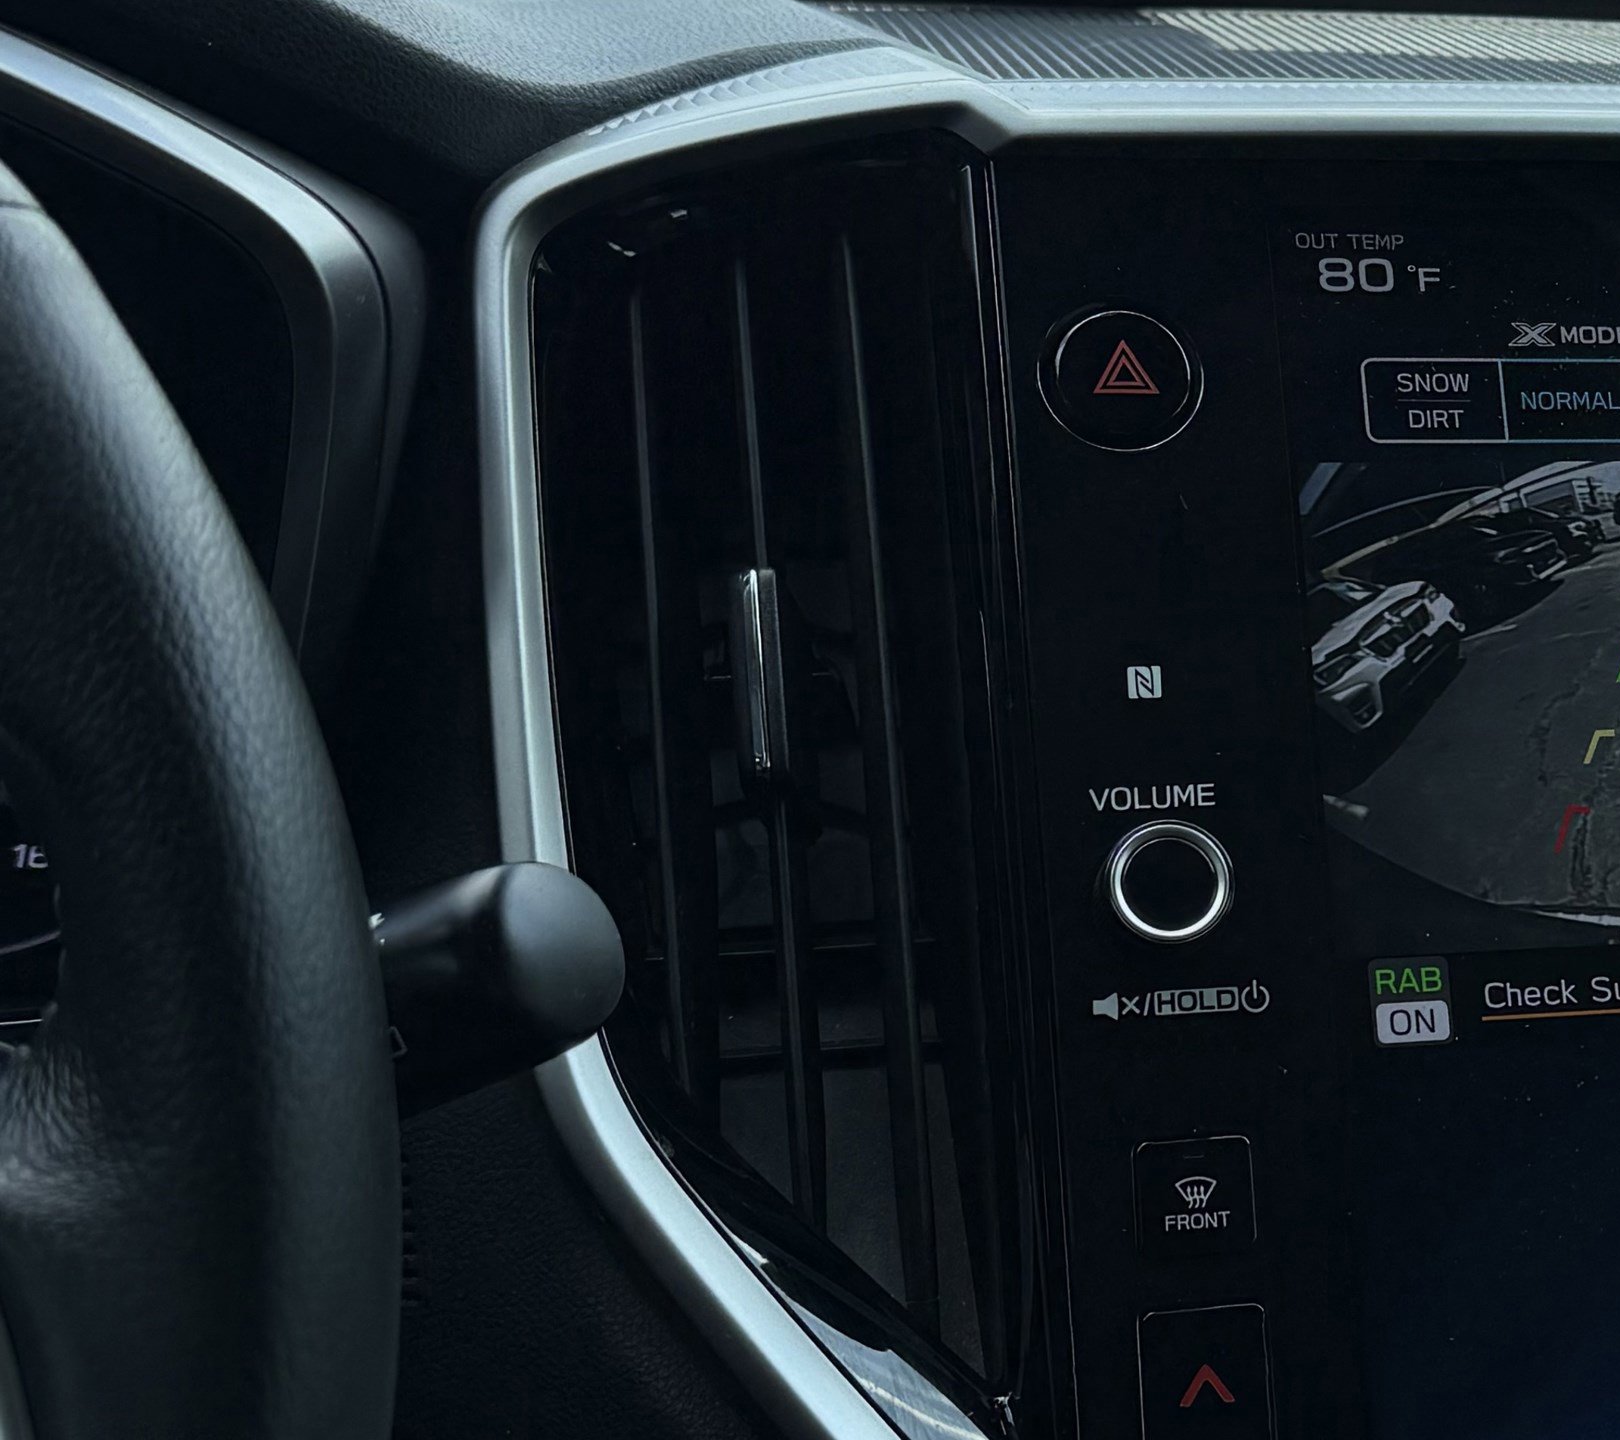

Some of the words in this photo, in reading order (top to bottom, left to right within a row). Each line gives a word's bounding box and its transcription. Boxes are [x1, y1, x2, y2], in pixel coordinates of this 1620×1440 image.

[1295, 232, 1339, 249] OUT
[1346, 233, 1404, 251] TEMP
[1318, 257, 1395, 293] 80
[1396, 372, 1470, 393] SNOW
[1408, 409, 1465, 429] DIRT
[1088, 783, 1216, 811] VOLUME
[1375, 966, 1442, 995] RAB
[1484, 979, 1578, 1009] Check
[1389, 1008, 1436, 1036] ON
[1165, 1210, 1231, 1232] FRONT
